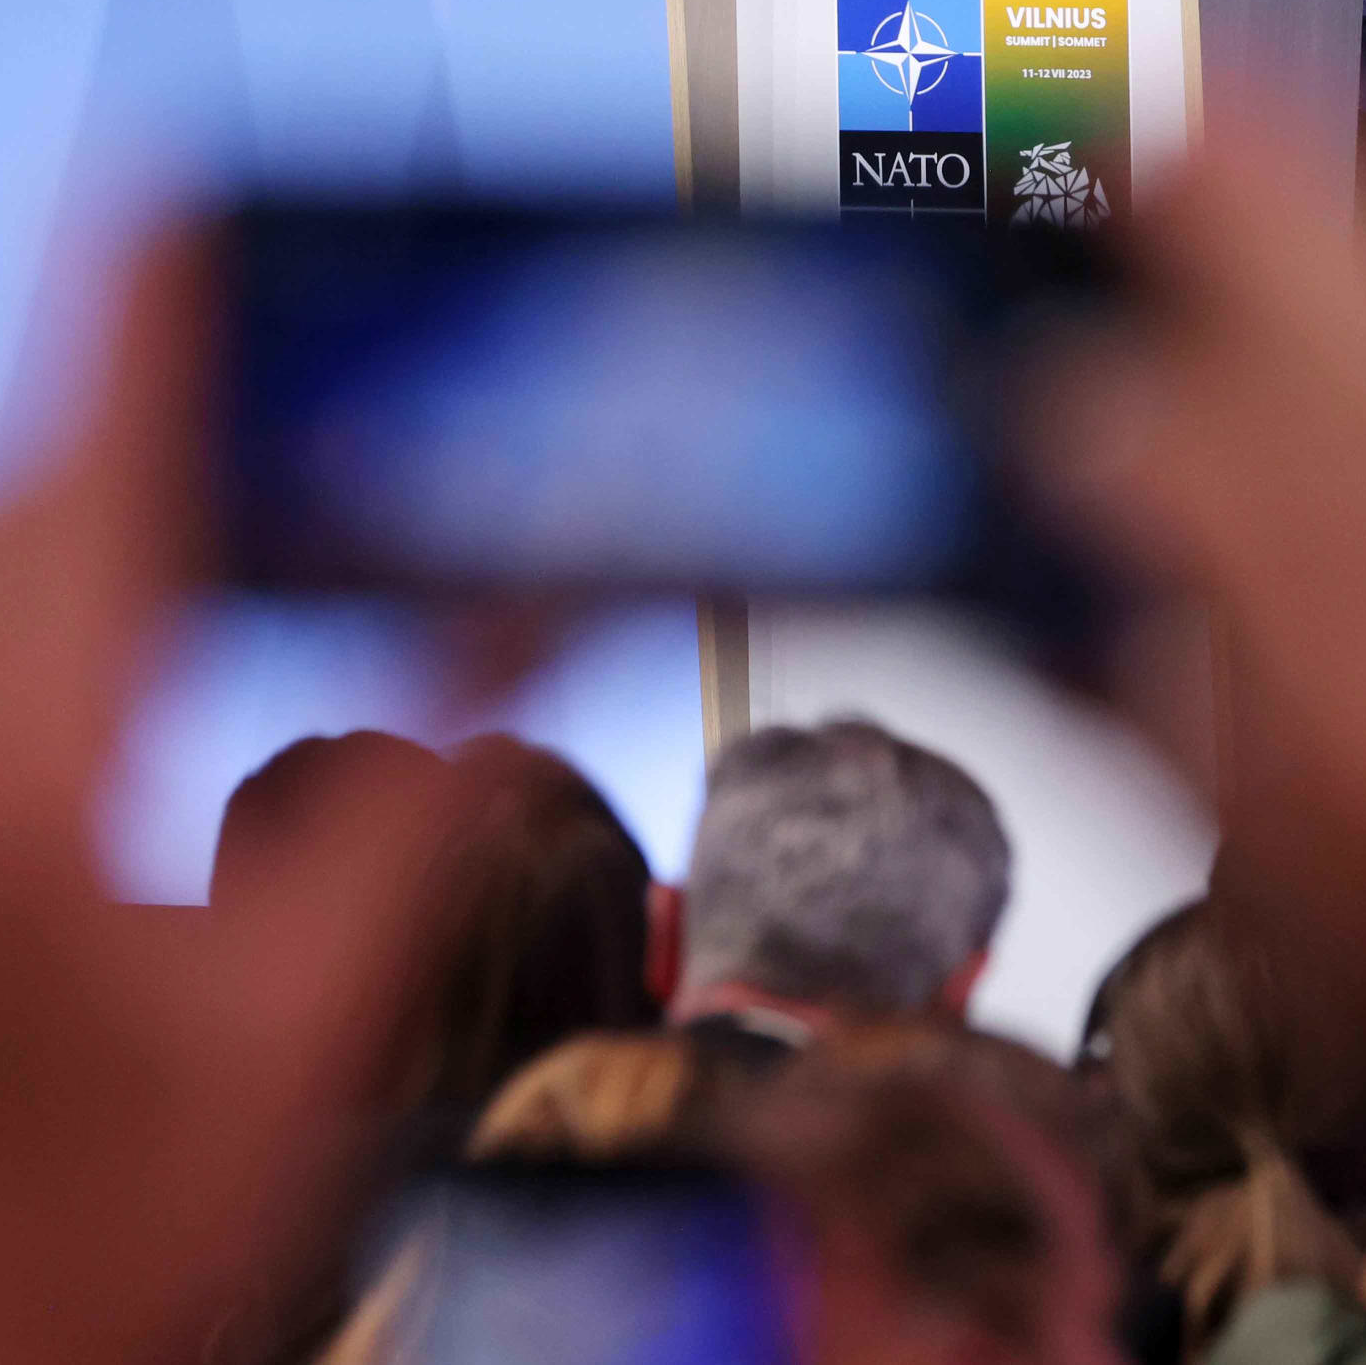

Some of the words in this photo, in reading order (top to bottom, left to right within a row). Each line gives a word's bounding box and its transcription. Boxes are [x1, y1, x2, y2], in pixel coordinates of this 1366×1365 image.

[1006, 6, 1107, 29] VILNIUS
[1005, 36, 1050, 47] SUMMIT
[1058, 36, 1107, 48] SOMMET
[1022, 69, 1050, 78] 11-12
[1050, 69, 1065, 79] VII
[1067, 69, 1092, 79] 2023
[852, 152, 970, 188] NATO
